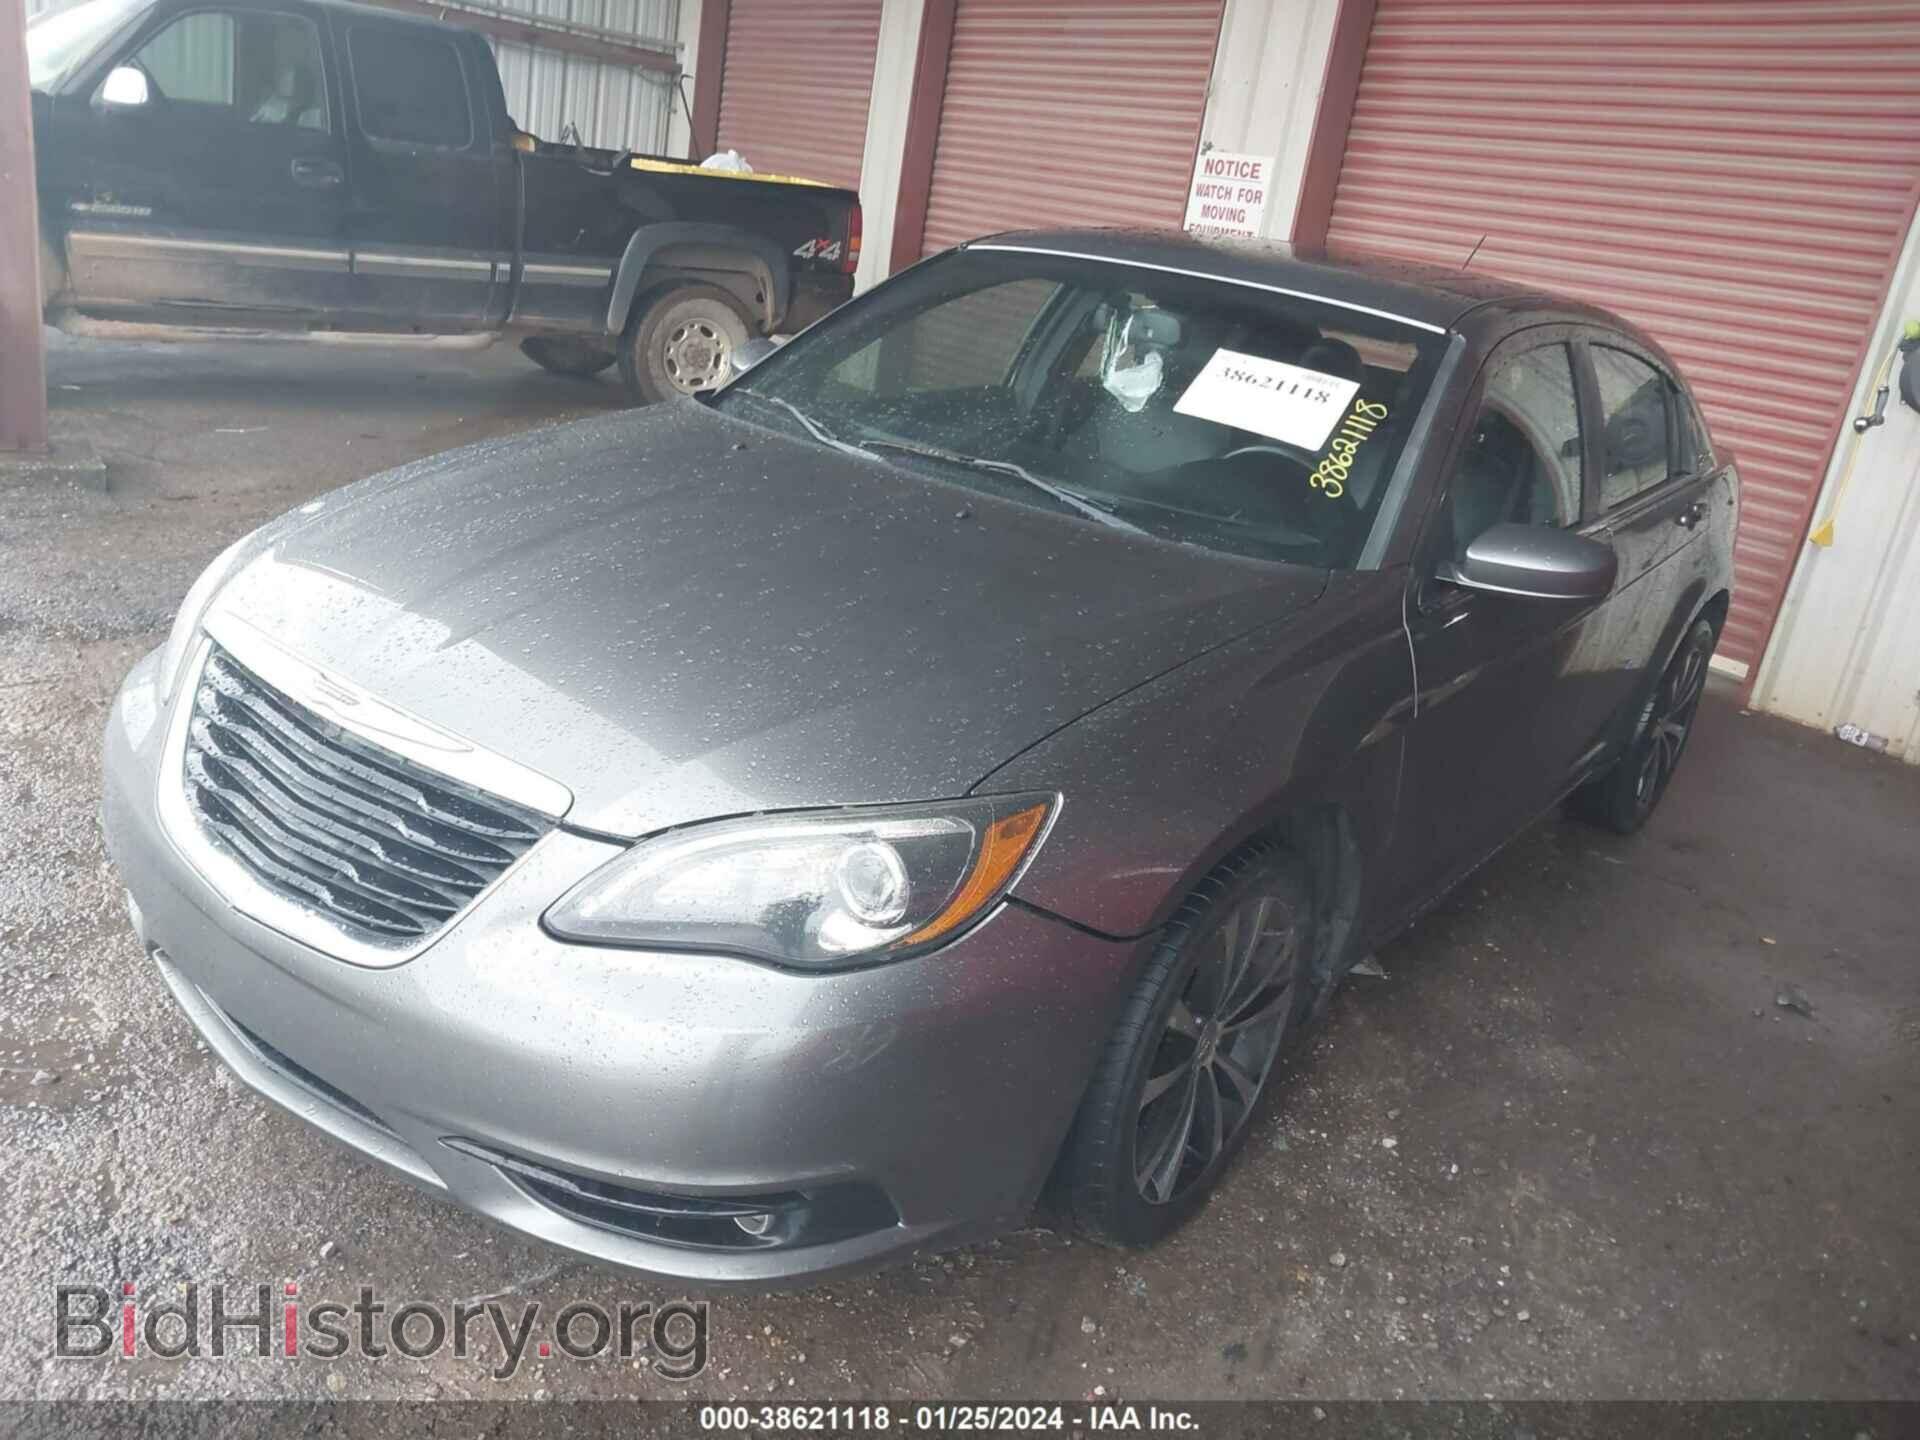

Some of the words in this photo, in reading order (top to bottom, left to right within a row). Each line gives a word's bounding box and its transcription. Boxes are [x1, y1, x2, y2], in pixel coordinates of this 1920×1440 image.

[1204, 157, 1262, 180] NOTICE
[1195, 183, 1232, 201] WATCH
[1237, 187, 1263, 204] FOR
[1200, 204, 1246, 223] MOVING
[1219, 366, 1331, 404] 38621118
[1309, 398, 1388, 499] 38621118
